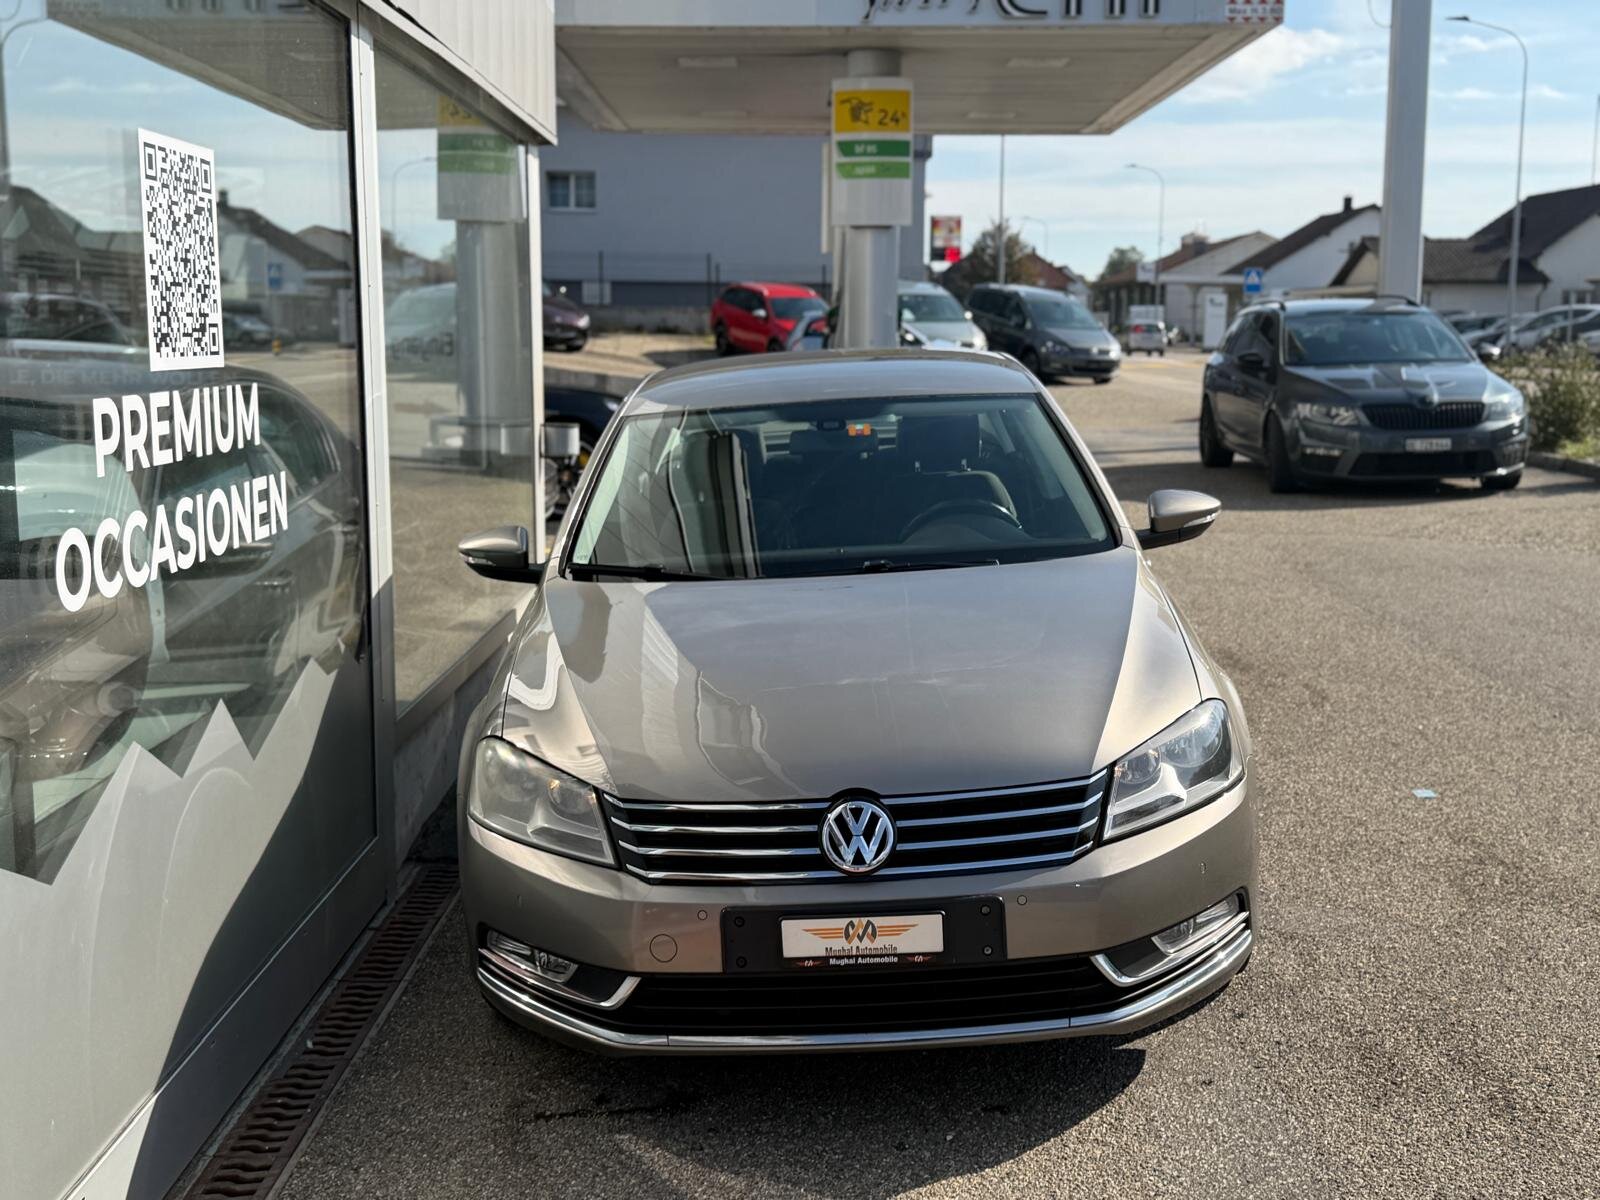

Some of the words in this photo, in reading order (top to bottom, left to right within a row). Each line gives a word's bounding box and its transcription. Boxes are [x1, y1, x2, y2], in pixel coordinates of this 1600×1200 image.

[92, 382, 261, 478] PREMIUM
[56, 471, 289, 612] OCCASIONEN
[829, 957, 855, 966] Mughal
[857, 956, 899, 964] Automobile
[856, 944, 898, 955] Automobile
